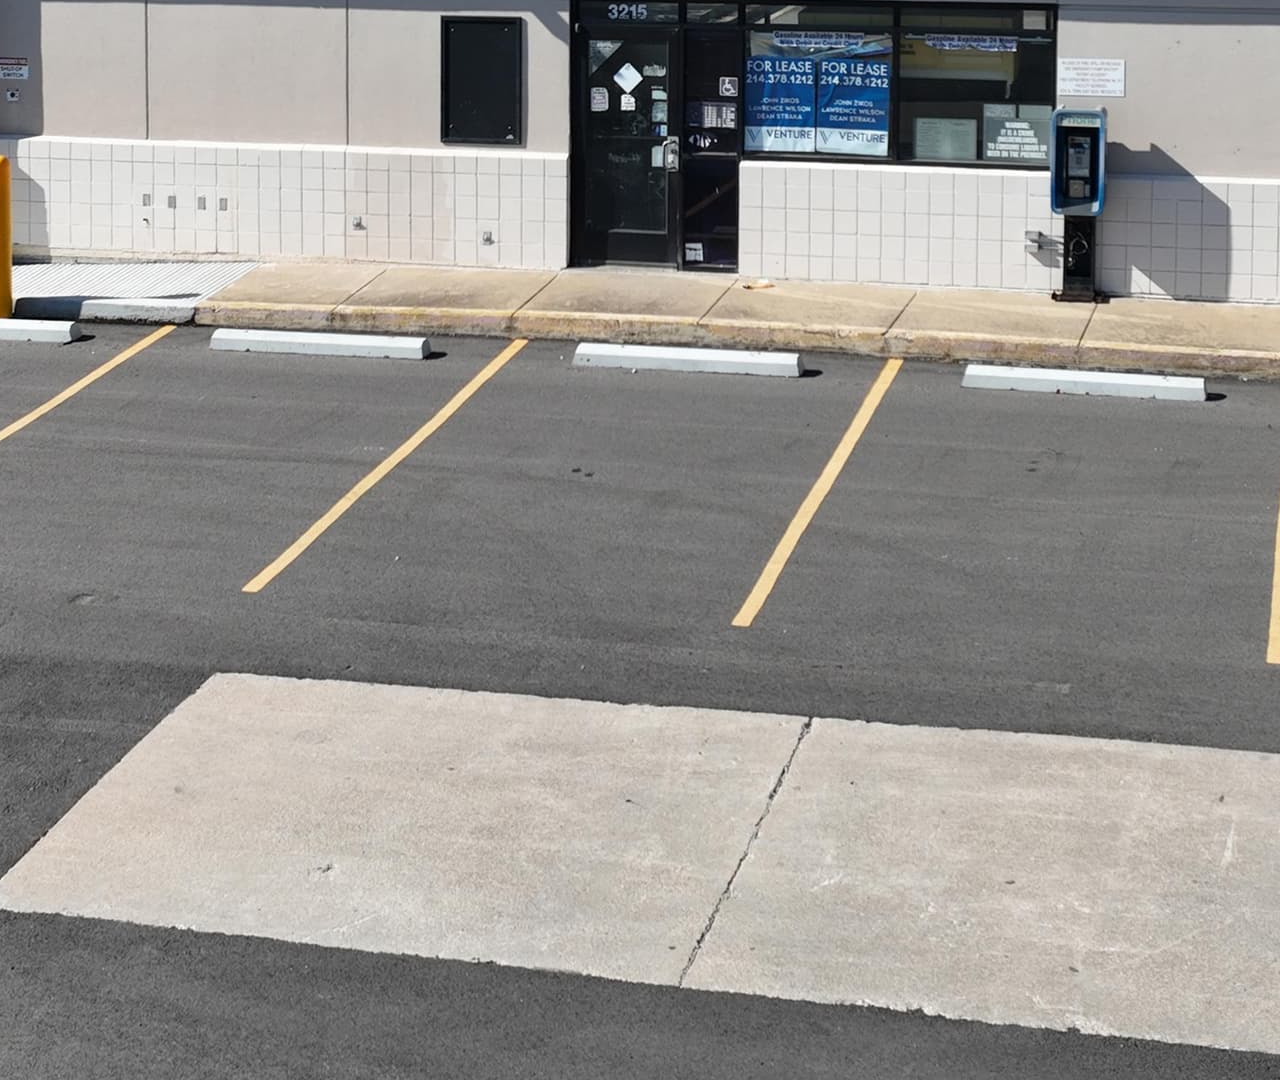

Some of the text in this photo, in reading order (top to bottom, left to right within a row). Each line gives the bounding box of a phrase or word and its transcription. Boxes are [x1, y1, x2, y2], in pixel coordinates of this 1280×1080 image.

[607, 3, 649, 20] 3215
[746, 61, 813, 73] FOR LEASE
[821, 61, 889, 77] FOR LEASE
[745, 74, 814, 85] 214.378.1212
[820, 75, 889, 88] 214.378.1212
[785, 105, 812, 113] WILSON
[821, 106, 886, 116] LAWRENCE WILSON
[829, 114, 848, 122] DEAN
[766, 128, 813, 140] VENTURE
[839, 131, 886, 144] VENTURE
